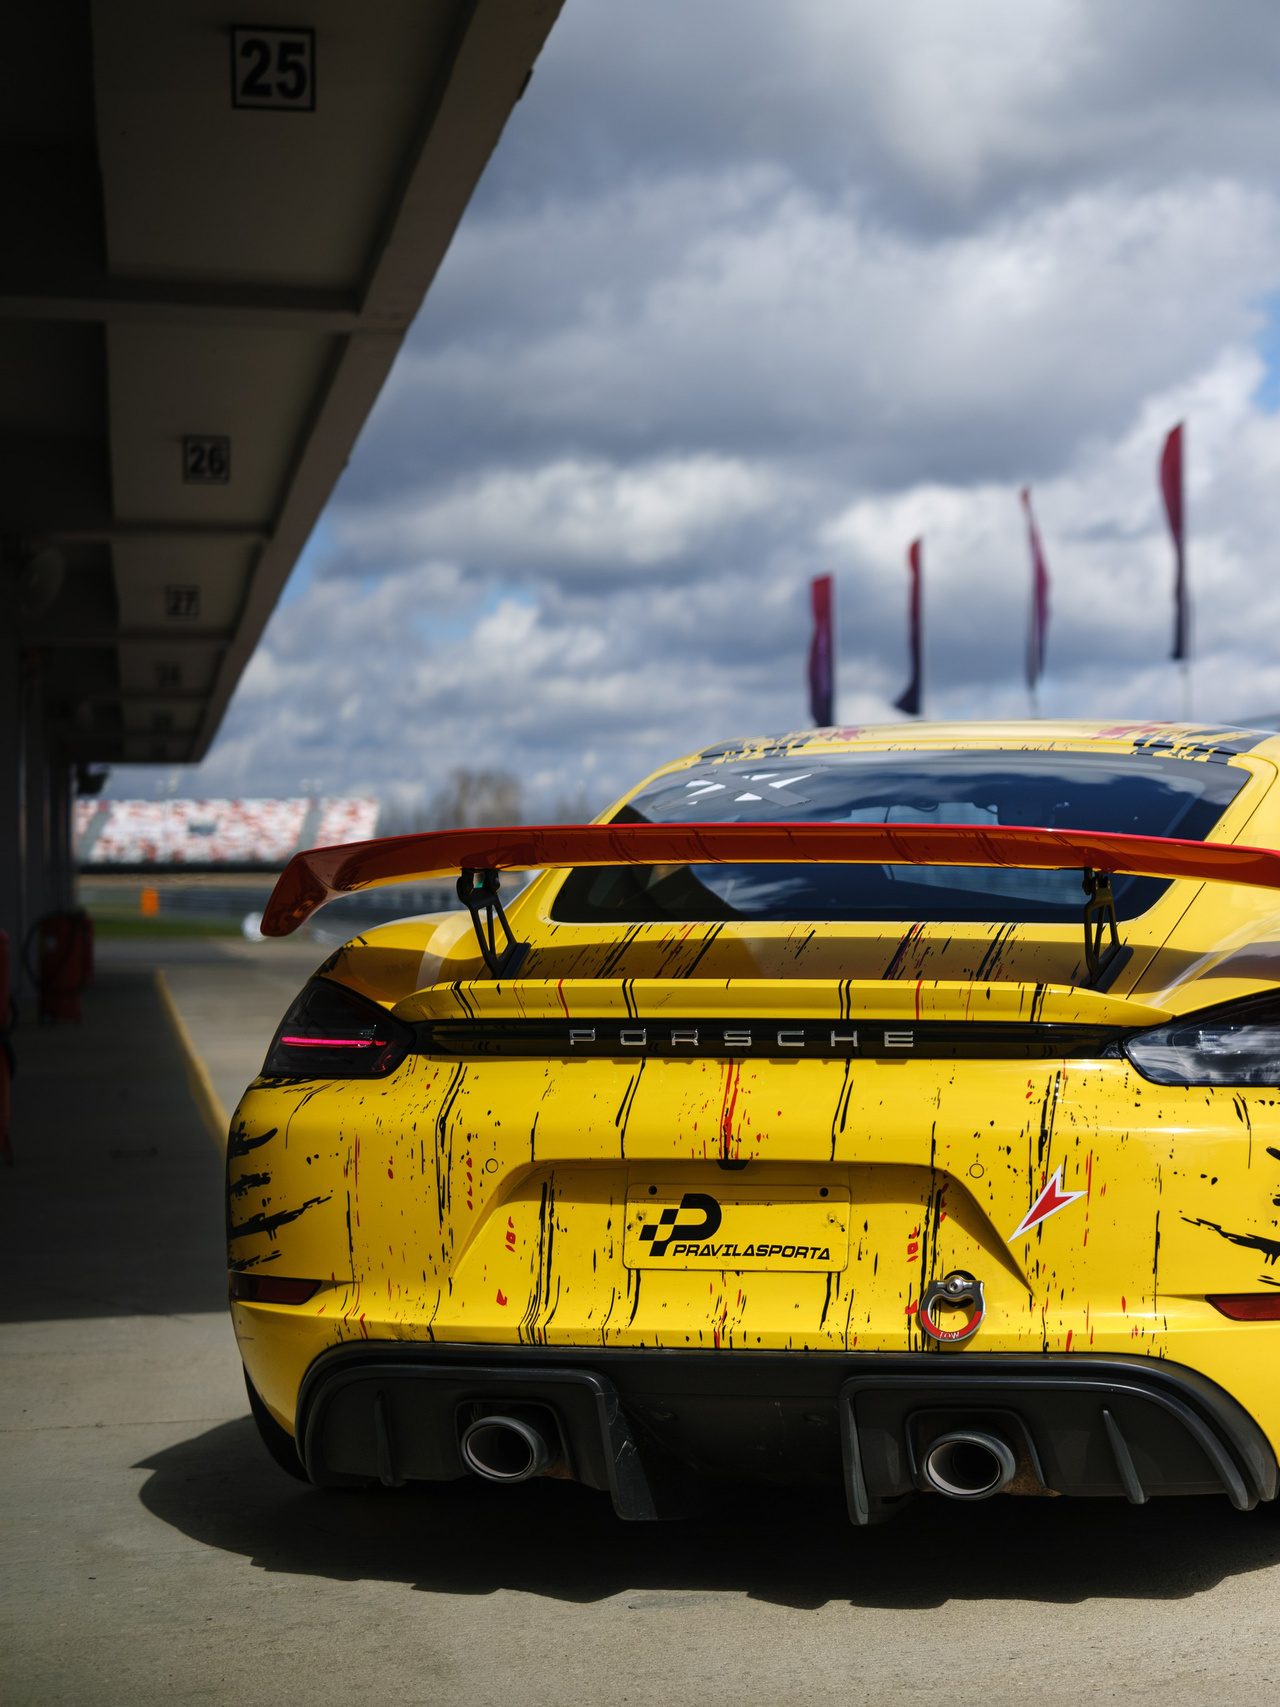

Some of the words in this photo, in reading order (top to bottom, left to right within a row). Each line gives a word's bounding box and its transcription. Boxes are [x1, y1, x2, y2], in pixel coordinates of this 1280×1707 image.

[240, 39, 307, 99] 25
[189, 444, 225, 477] 26
[568, 1027, 915, 1048] PORSCHE
[673, 1244, 831, 1261] PRAVILASPORTA
[939, 1331, 960, 1340] TOW
